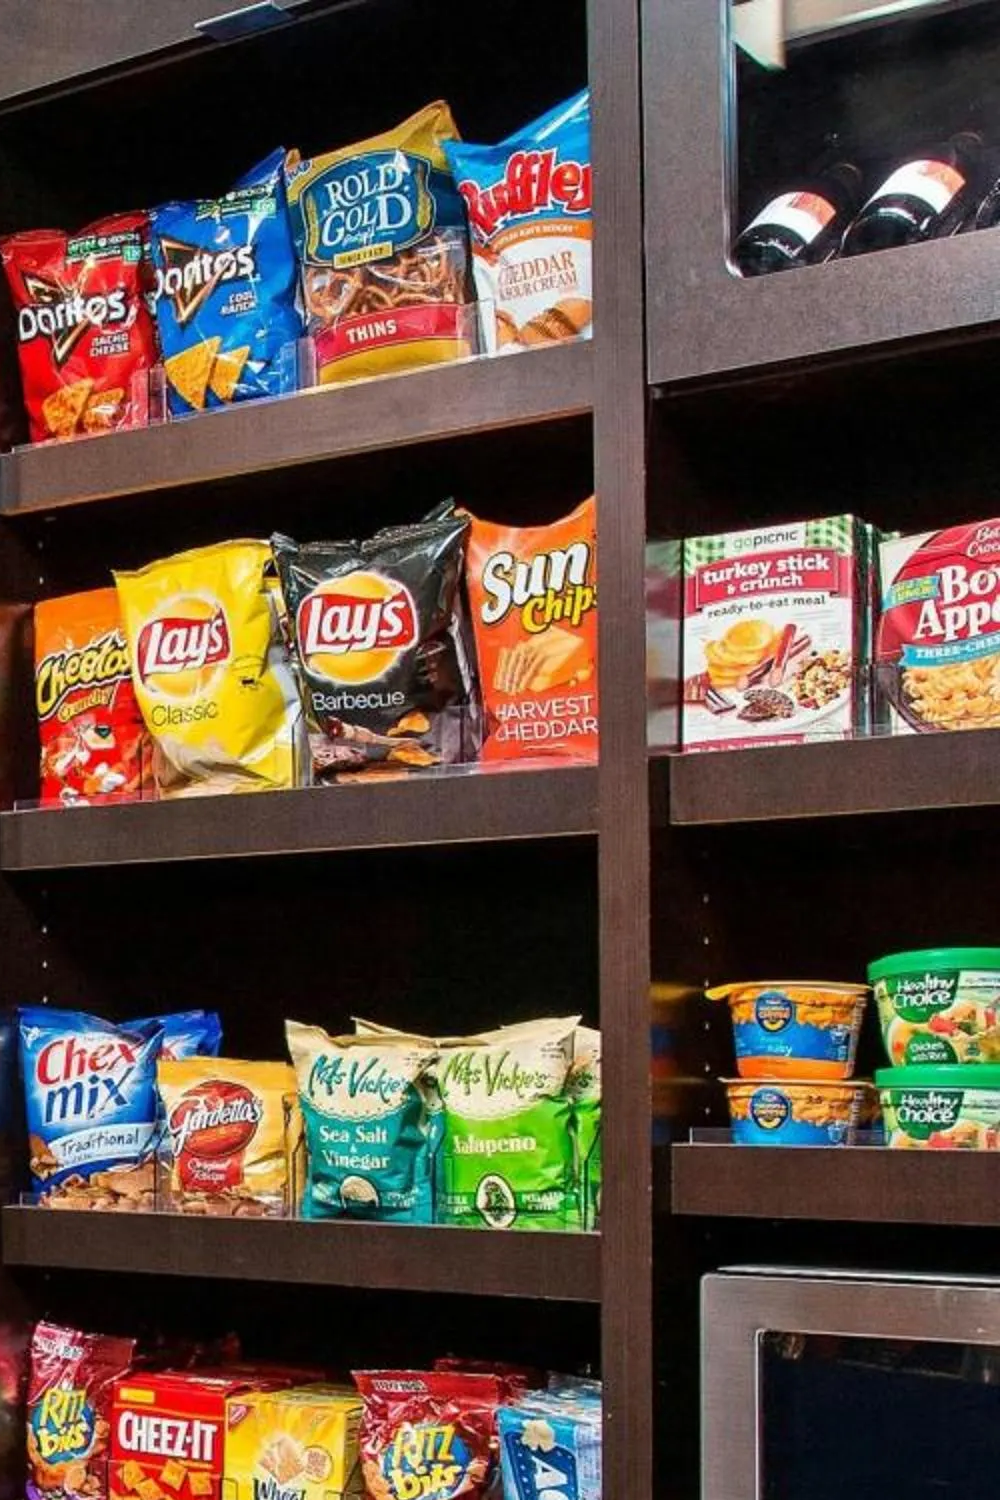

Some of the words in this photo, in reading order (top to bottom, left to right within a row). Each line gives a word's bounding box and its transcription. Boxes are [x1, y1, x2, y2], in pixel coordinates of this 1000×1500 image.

[325, 161, 405, 204] ROLD
[321, 192, 413, 247] GOLD
[18, 289, 127, 342] Doritos
[346, 318, 398, 344] THINS
[481, 542, 591, 625] Sun
[702, 561, 771, 586] turkey
[777, 553, 831, 573] stick
[740, 573, 804, 594] crunch
[521, 584, 597, 633] Chip
[707, 599, 788, 619] ready-to-eat
[792, 595, 827, 607] meal
[304, 597, 406, 655] Lay's
[143, 616, 224, 676] Lay's
[150, 700, 220, 727] Classic
[312, 691, 405, 712] Barbecue
[495, 693, 594, 723] HARVEST
[495, 716, 599, 743] CHEDDAR
[897, 972, 955, 994] Healthy
[893, 990, 953, 1009] Choice
[36, 1034, 144, 1087] Chex
[46, 1067, 135, 1124] mix
[901, 1091, 959, 1112] Healthy
[898, 1106, 956, 1125] Choice
[59, 1129, 140, 1158] Traditional
[319, 1126, 351, 1143] Sea
[355, 1124, 388, 1143] Salt
[321, 1149, 390, 1171] Vinegar
[117, 1410, 218, 1461] CHEEZ-IT
